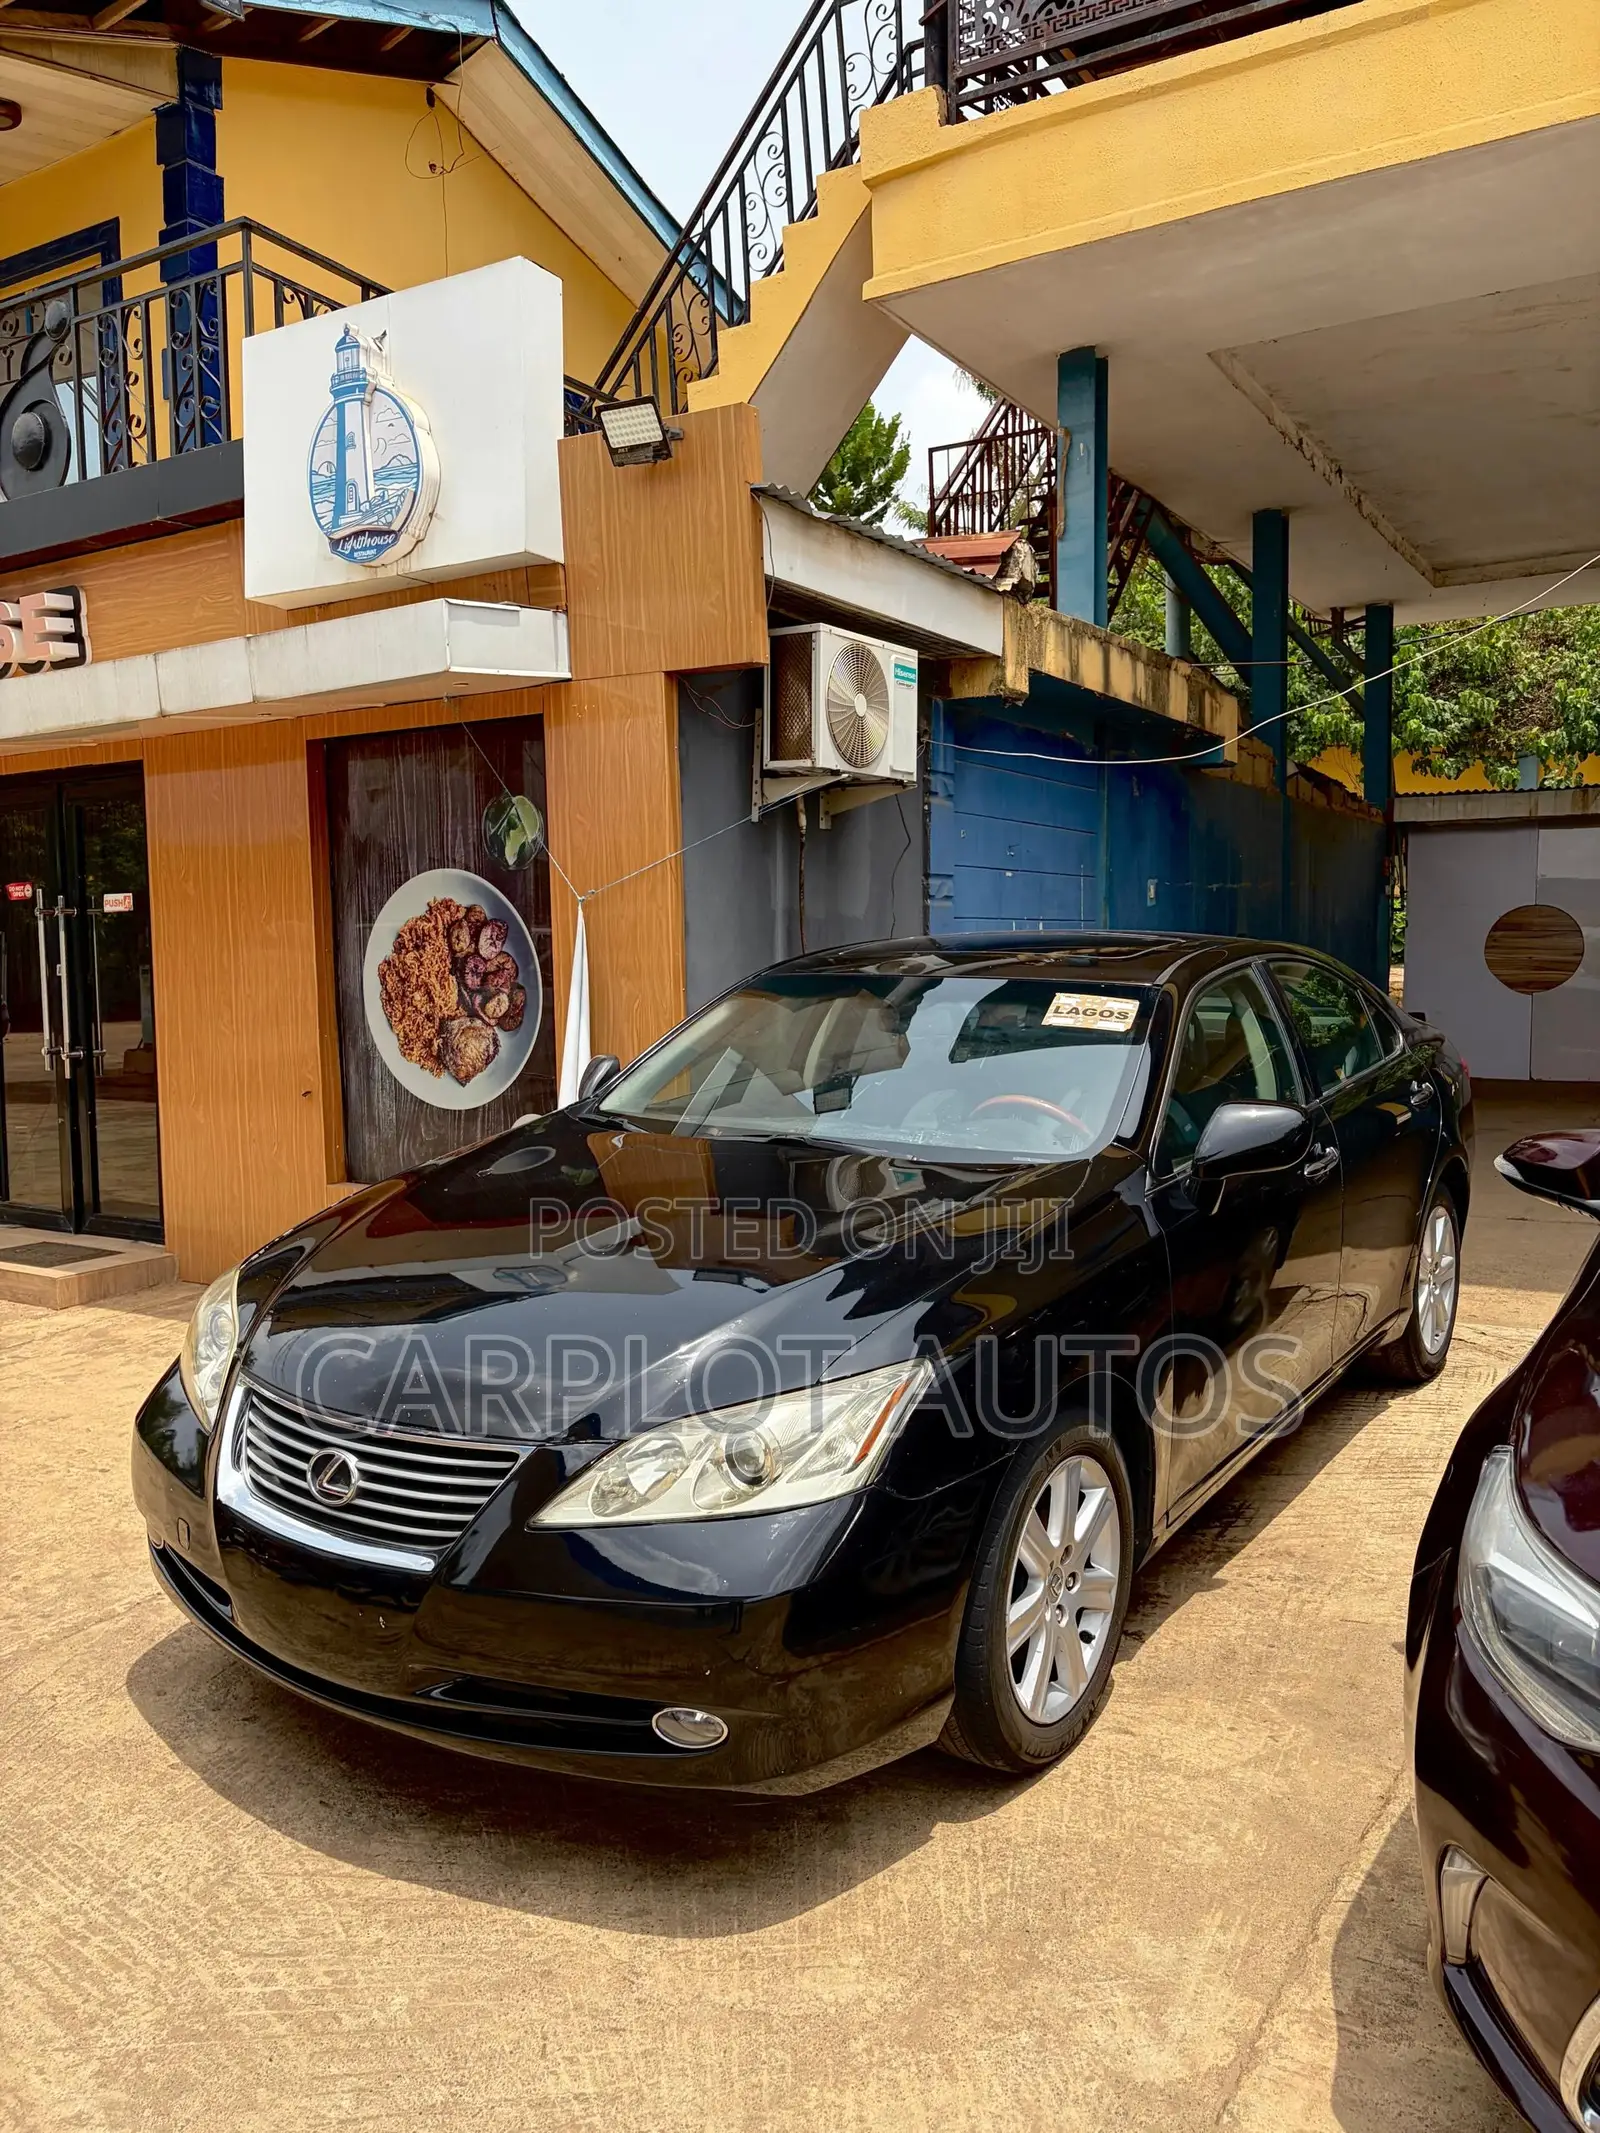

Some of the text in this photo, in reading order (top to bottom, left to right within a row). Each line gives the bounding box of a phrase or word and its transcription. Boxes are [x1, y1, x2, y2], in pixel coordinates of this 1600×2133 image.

[894, 667, 916, 680] Hisense
[104, 899, 124, 907] PUSH
[1053, 1006, 1130, 1020] LAGOS
